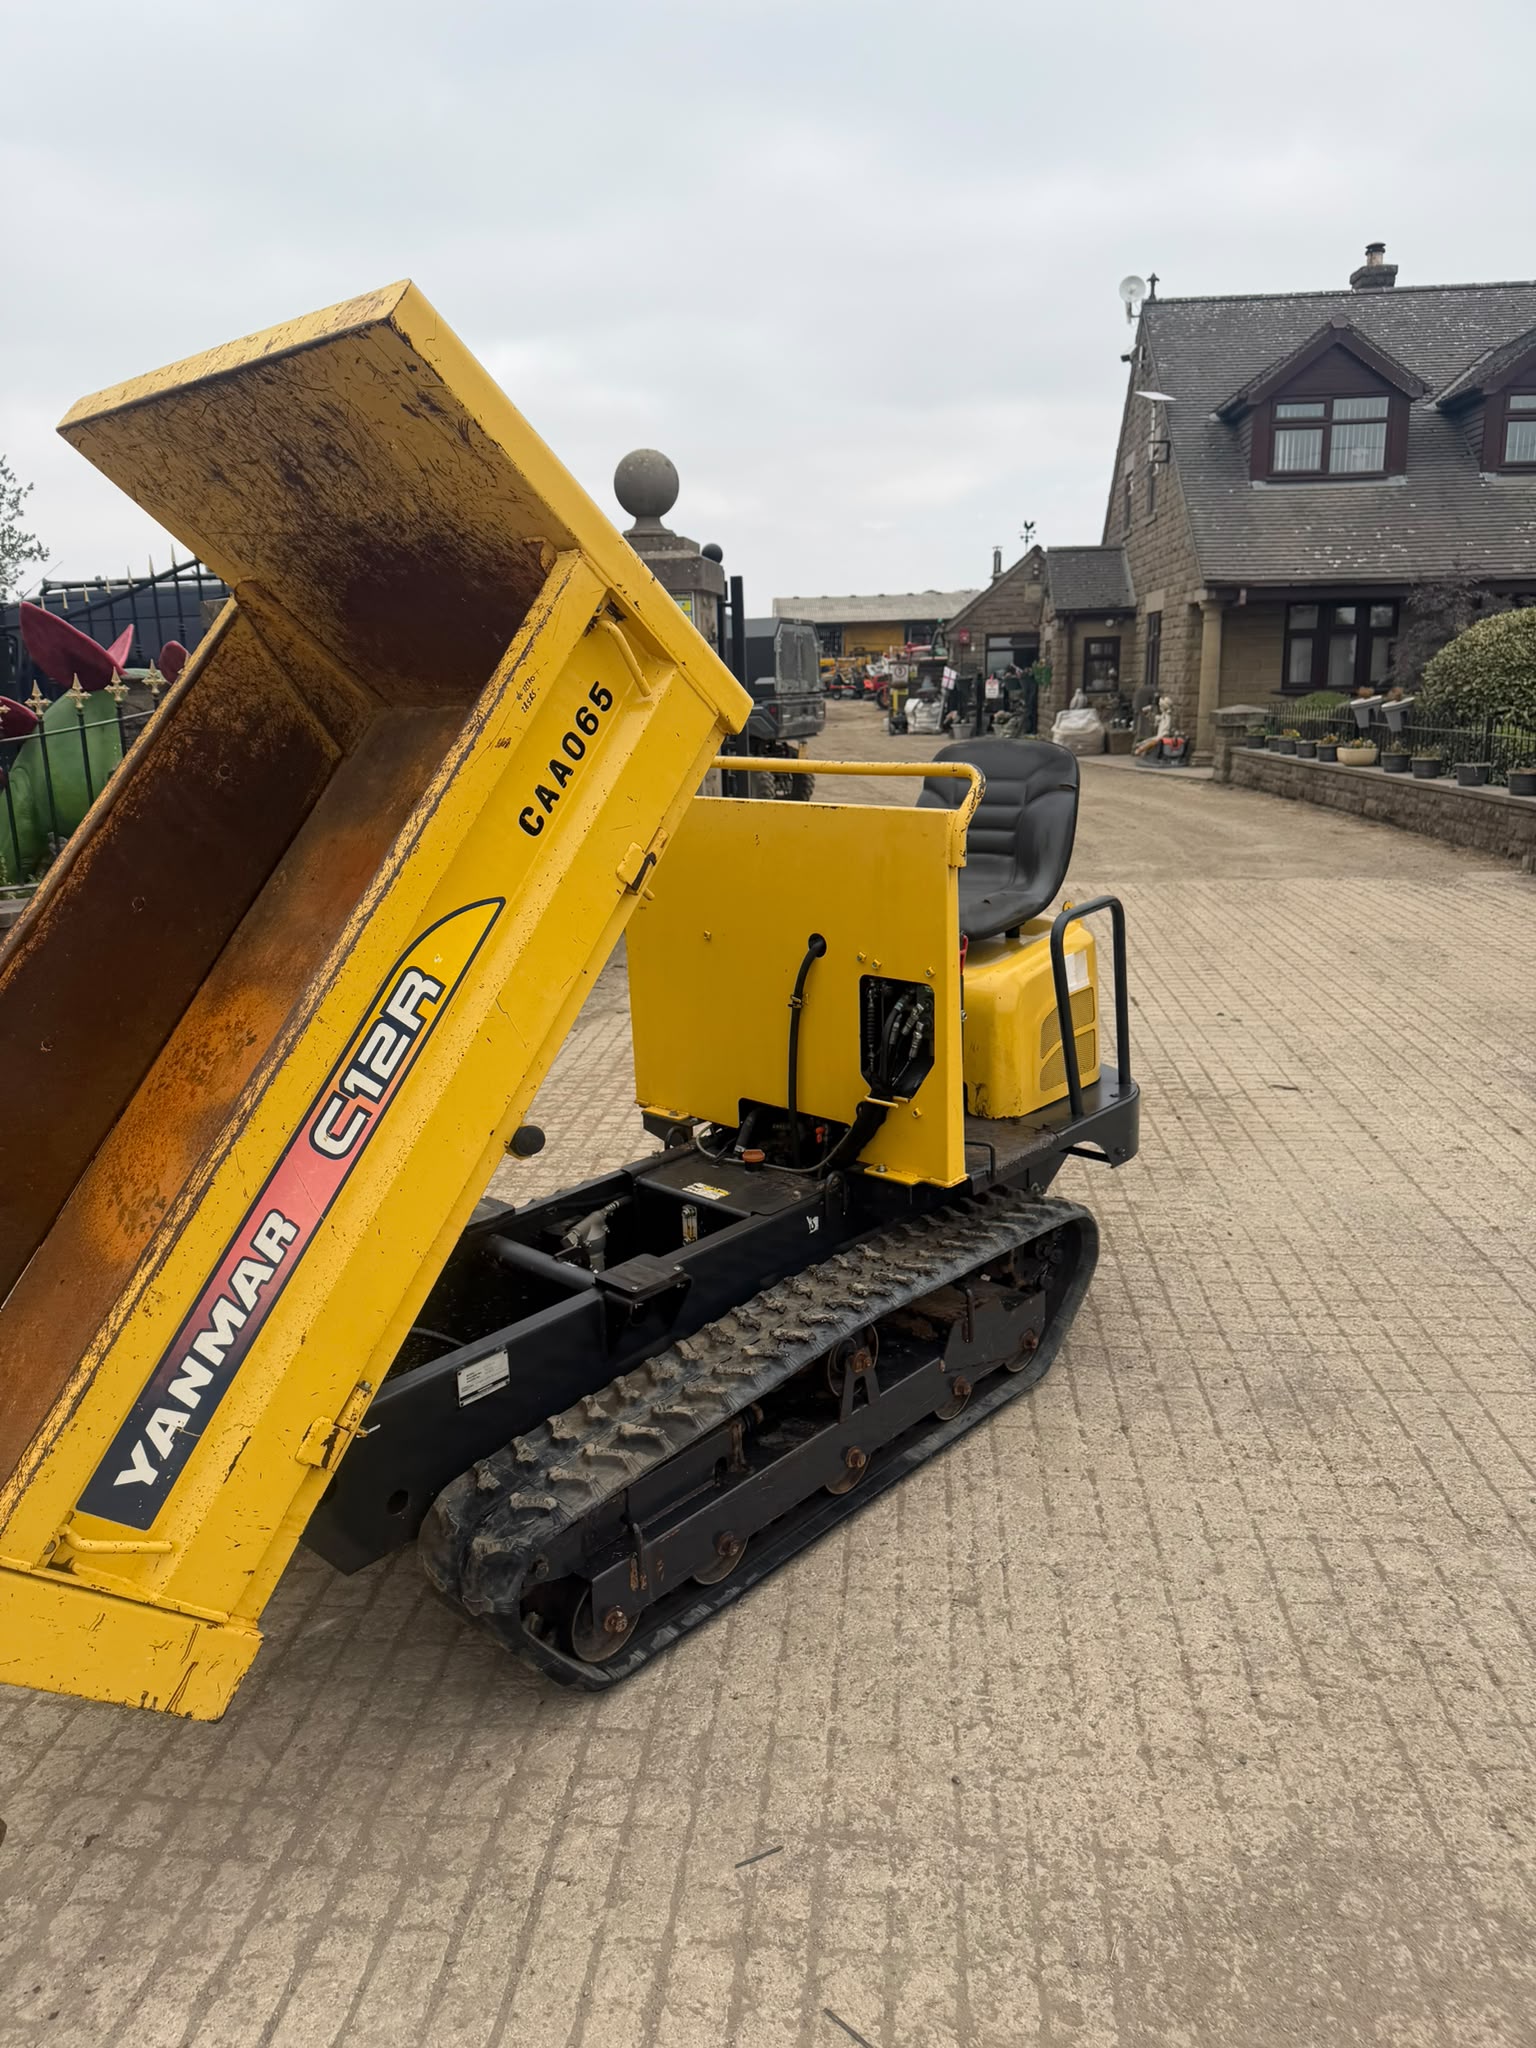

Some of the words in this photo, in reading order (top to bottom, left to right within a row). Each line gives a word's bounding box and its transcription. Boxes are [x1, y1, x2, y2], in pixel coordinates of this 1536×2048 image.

[518, 681, 613, 837] CAA065
[311, 968, 444, 1158] C12R
[113, 1210, 299, 1486] YANMAR
